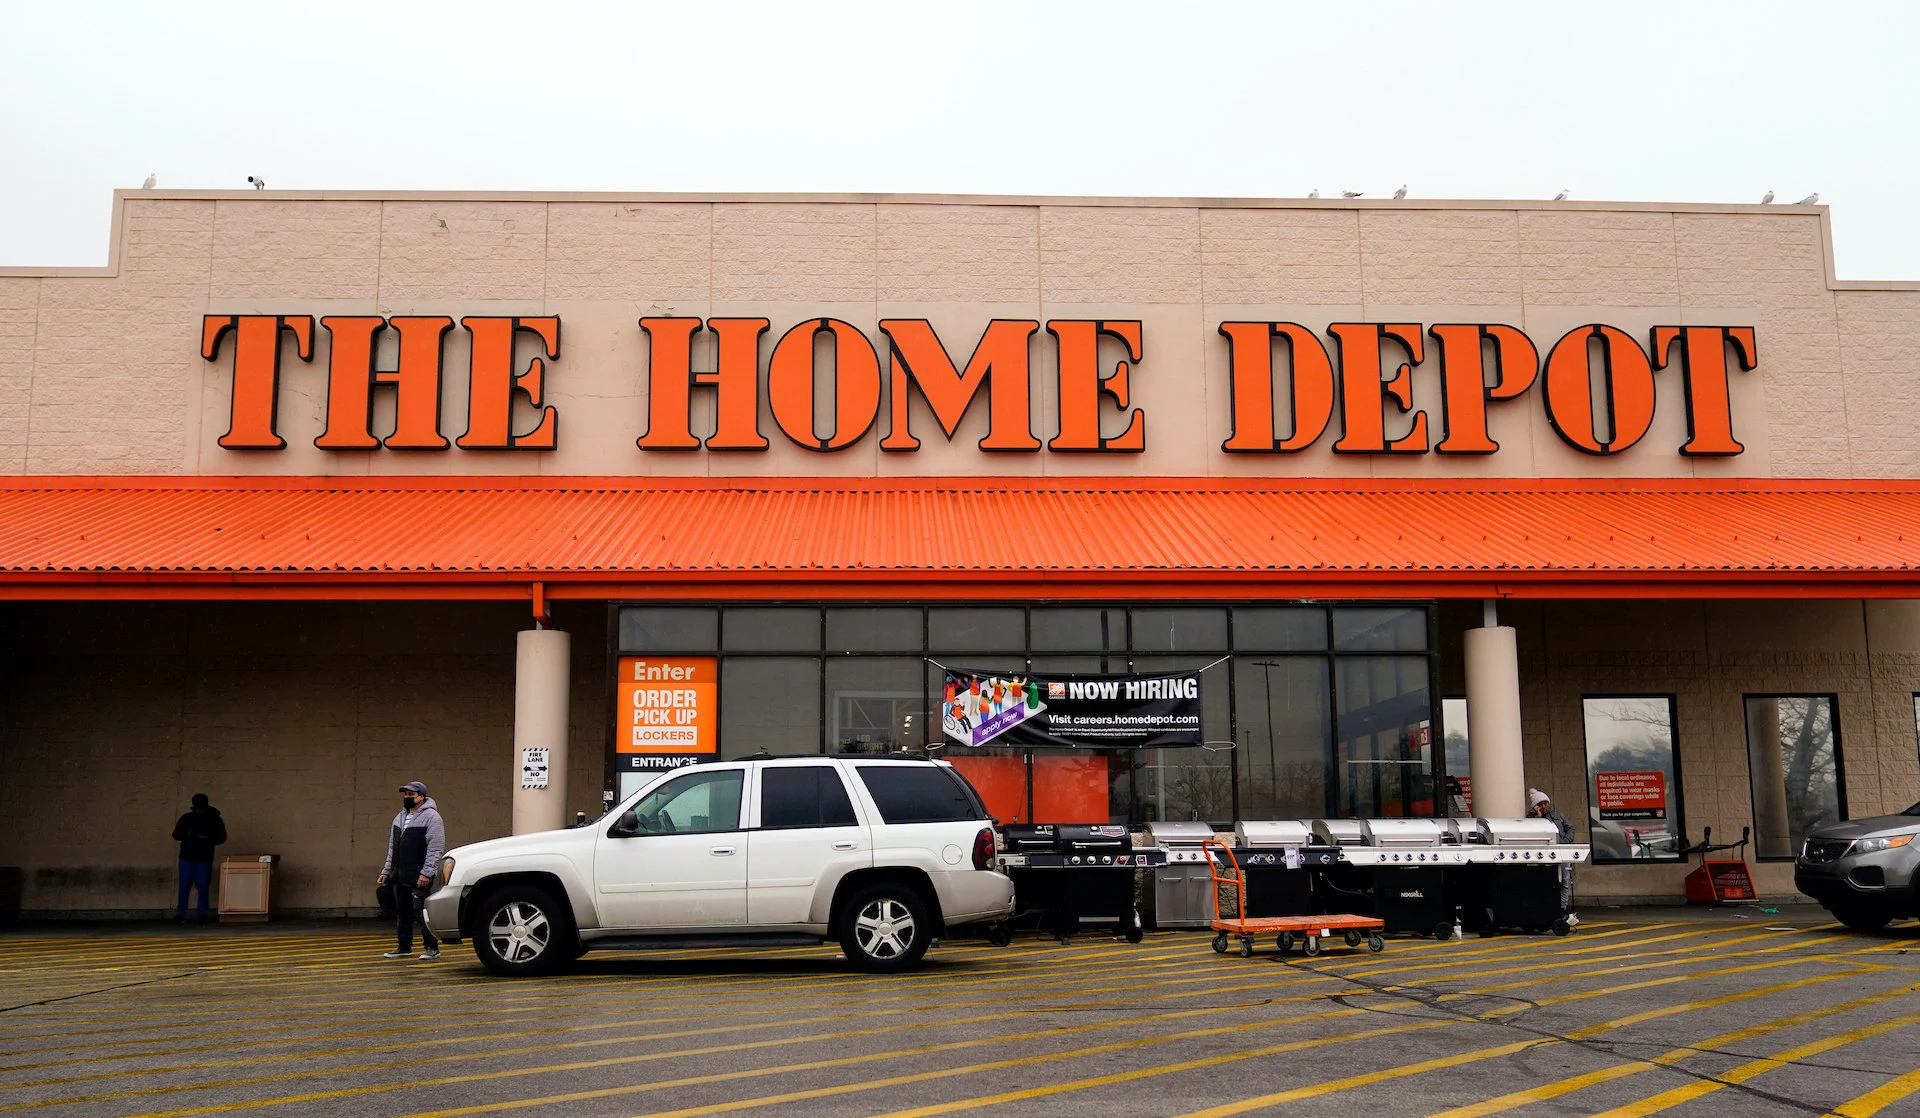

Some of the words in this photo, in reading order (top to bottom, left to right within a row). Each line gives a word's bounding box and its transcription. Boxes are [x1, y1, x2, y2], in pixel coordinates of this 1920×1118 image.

[201, 314, 561, 451] THE
[636, 317, 1146, 453] HOME
[1218, 320, 1758, 457] DEPOT
[634, 661, 695, 681] Enter
[633, 689, 697, 708] ORDER
[1068, 682, 1119, 700] NOW
[1125, 678, 1198, 700] HIRING
[633, 709, 671, 724] PICK
[675, 709, 697, 724] UP
[981, 720, 1001, 736] apply
[1002, 712, 1018, 724] now
[1048, 714, 1071, 724] Visit
[1073, 714, 1199, 725] careers.homedepot.com
[636, 731, 695, 741] LOCKERS
[632, 757, 698, 767] ENTRANCE
